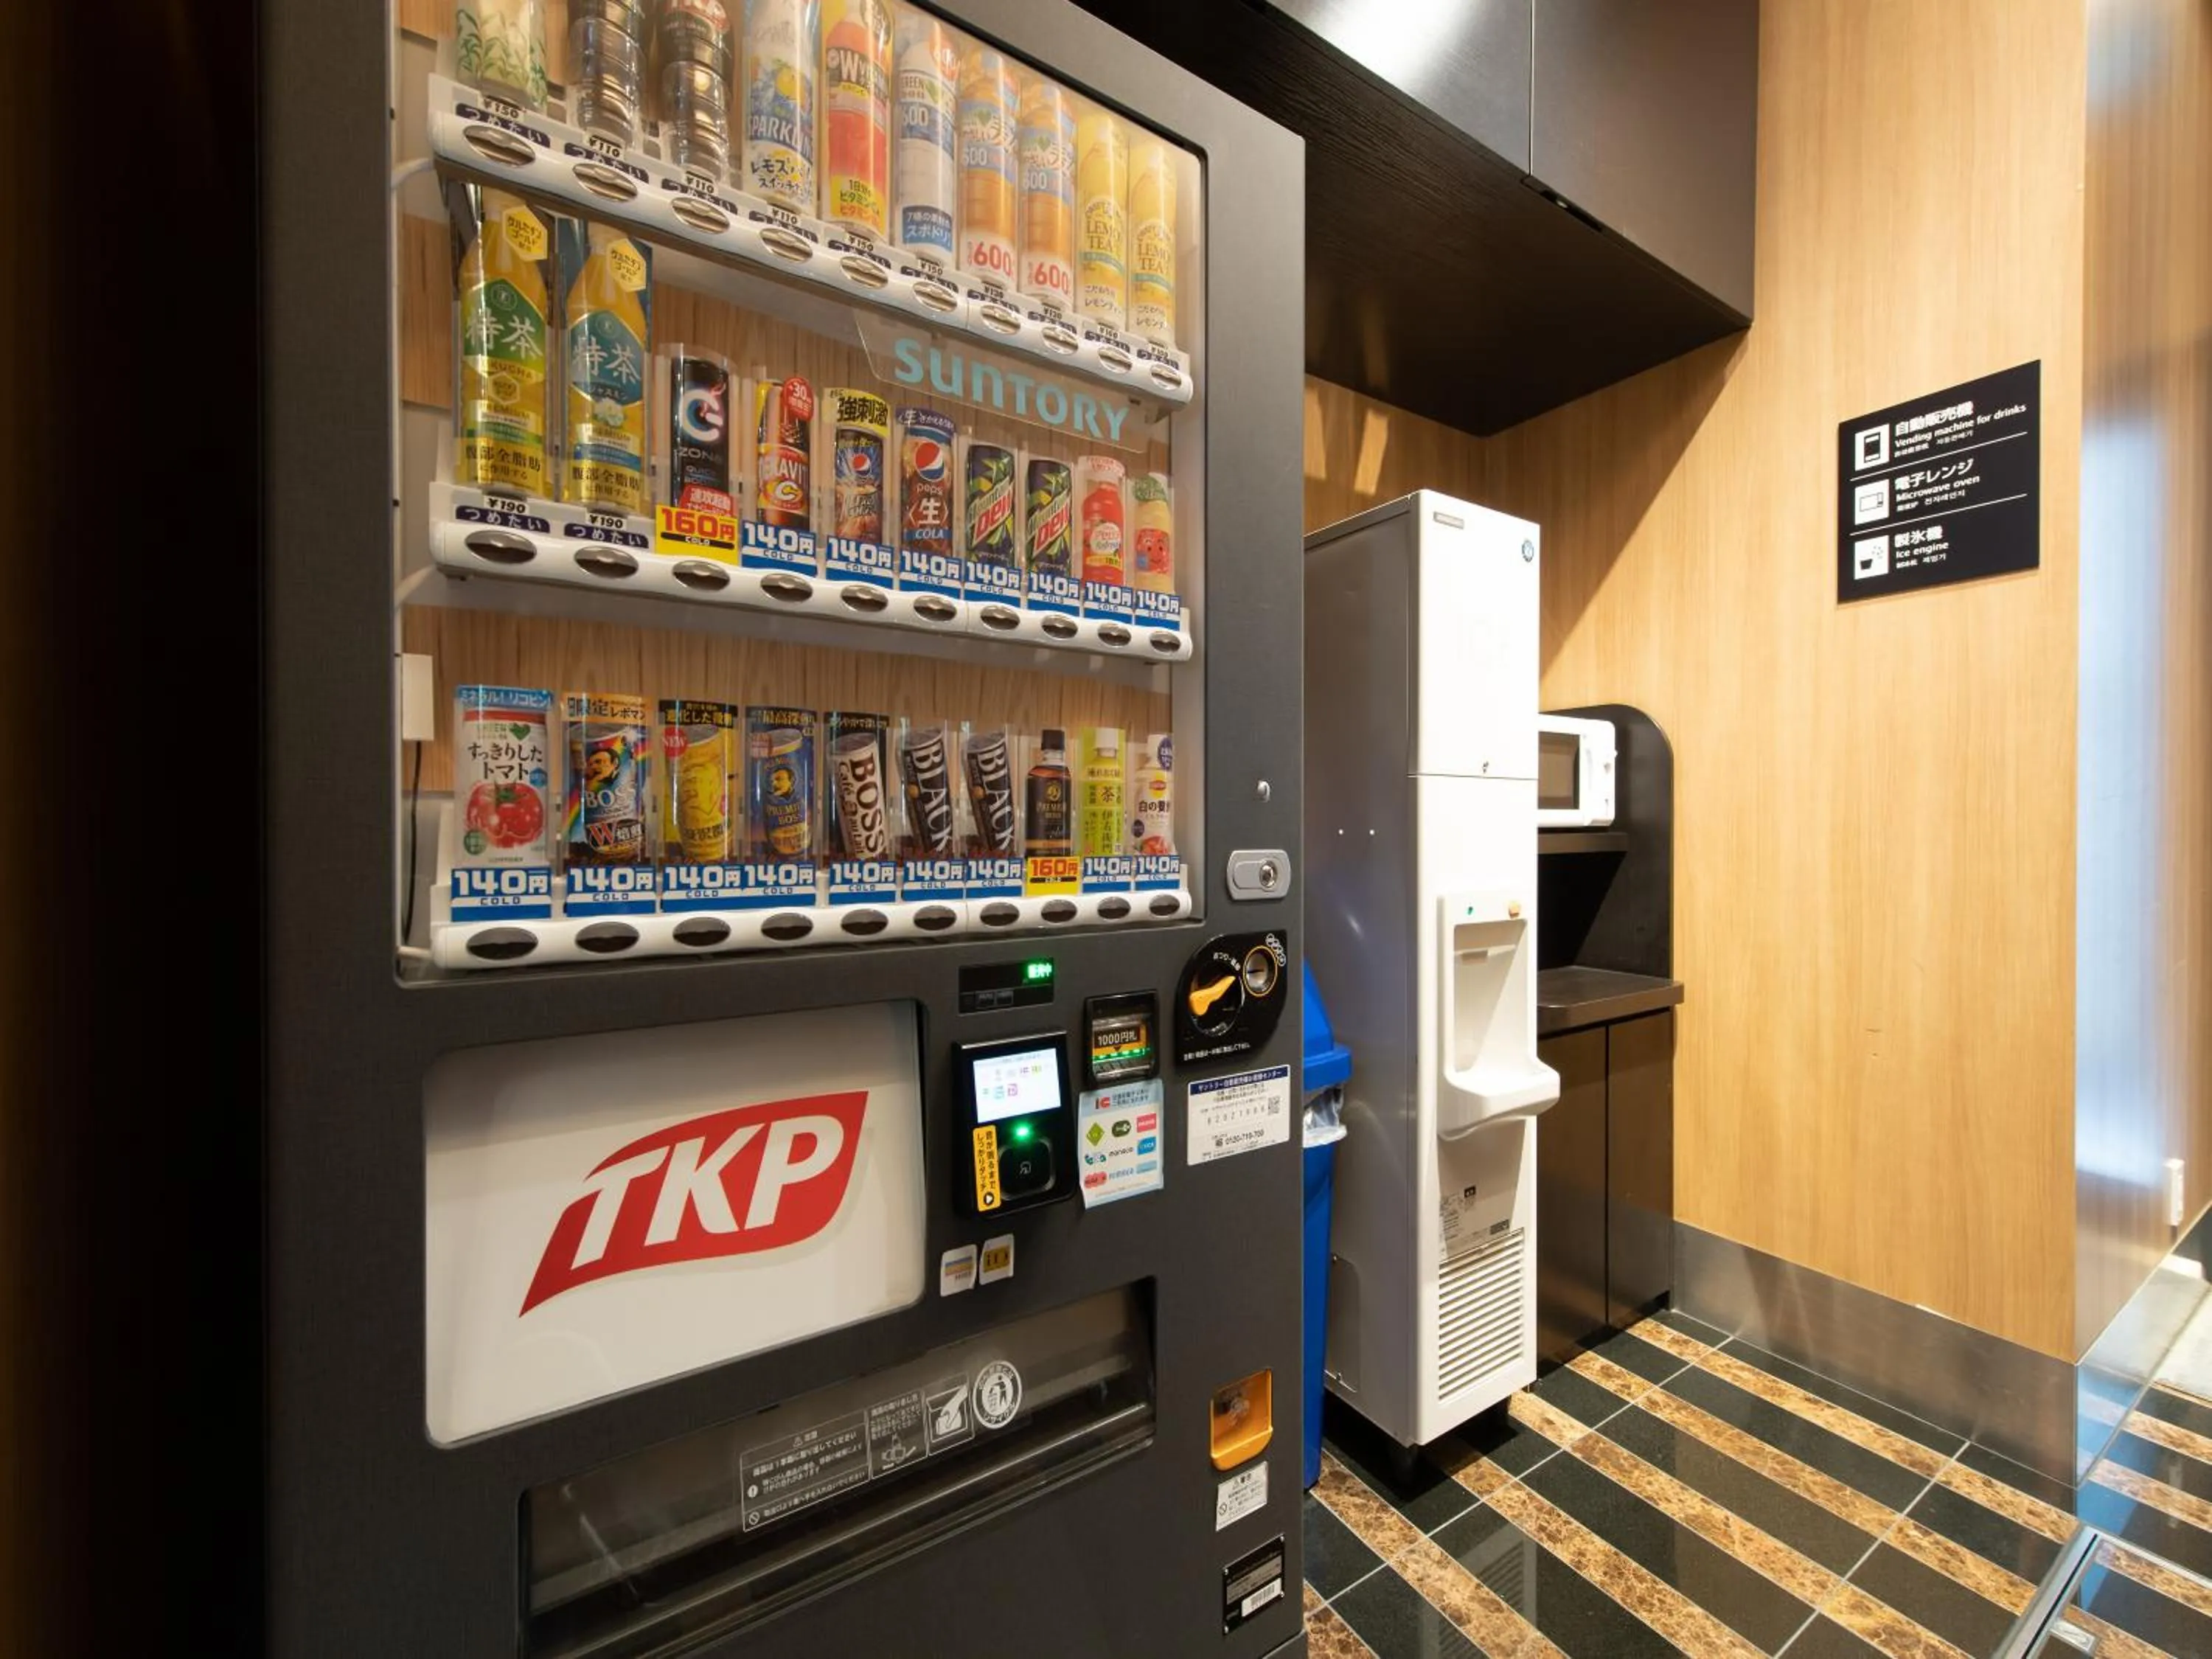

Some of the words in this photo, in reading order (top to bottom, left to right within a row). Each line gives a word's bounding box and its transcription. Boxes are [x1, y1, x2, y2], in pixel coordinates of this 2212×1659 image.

[589, 137, 621, 158] ¥110
[686, 176, 714, 194] ¥110
[974, 241, 1012, 277] 600
[572, 335, 641, 384] 特茶
[893, 337, 1130, 442] SUNTORY
[838, 396, 888, 426] 強刺激
[1894, 431, 1933, 448] Vending
[1934, 420, 1975, 437] machine
[1977, 414, 1992, 425] for
[1993, 403, 2027, 419] drinks
[678, 446, 714, 462] ZON
[1895, 458, 1974, 490] 電子レンジ
[1896, 481, 1950, 502] Microwave
[1953, 475, 1980, 488] oven
[488, 498, 526, 514] ¥190
[918, 498, 942, 524] 生
[464, 509, 543, 531] つめたい
[589, 515, 624, 529] ¥190
[661, 507, 735, 542] 160円
[571, 526, 642, 546] つめたい
[744, 523, 815, 556] 140円
[829, 537, 892, 569] 140円
[1896, 548, 1910, 558] Ice
[1913, 541, 1949, 556] engine
[902, 550, 959, 580] 140円
[967, 560, 1020, 590] 140円
[1031, 572, 1079, 597] 140円
[1085, 581, 1132, 606] 140円
[1135, 591, 1180, 613] 140円
[467, 742, 543, 762] すっきりした
[483, 762, 529, 780] トマト
[849, 753, 884, 853] BOSS
[911, 741, 953, 852] BLACK
[977, 744, 1014, 850] BLACK
[745, 864, 813, 887] 140円
[832, 863, 894, 883] 140円
[906, 861, 964, 882] 140円
[968, 860, 1021, 879] 140円
[1030, 860, 1078, 877] 160円
[1085, 858, 1130, 875] 140円
[1136, 856, 1179, 874] 140円
[454, 869, 548, 895] 140円
[570, 867, 655, 891] 140円
[665, 866, 740, 889] 140円
[480, 897, 521, 905] COLD
[593, 892, 629, 902] COLD
[686, 889, 719, 898] COLD
[763, 886, 793, 894] COLD
[571, 1113, 845, 1271] TKP
